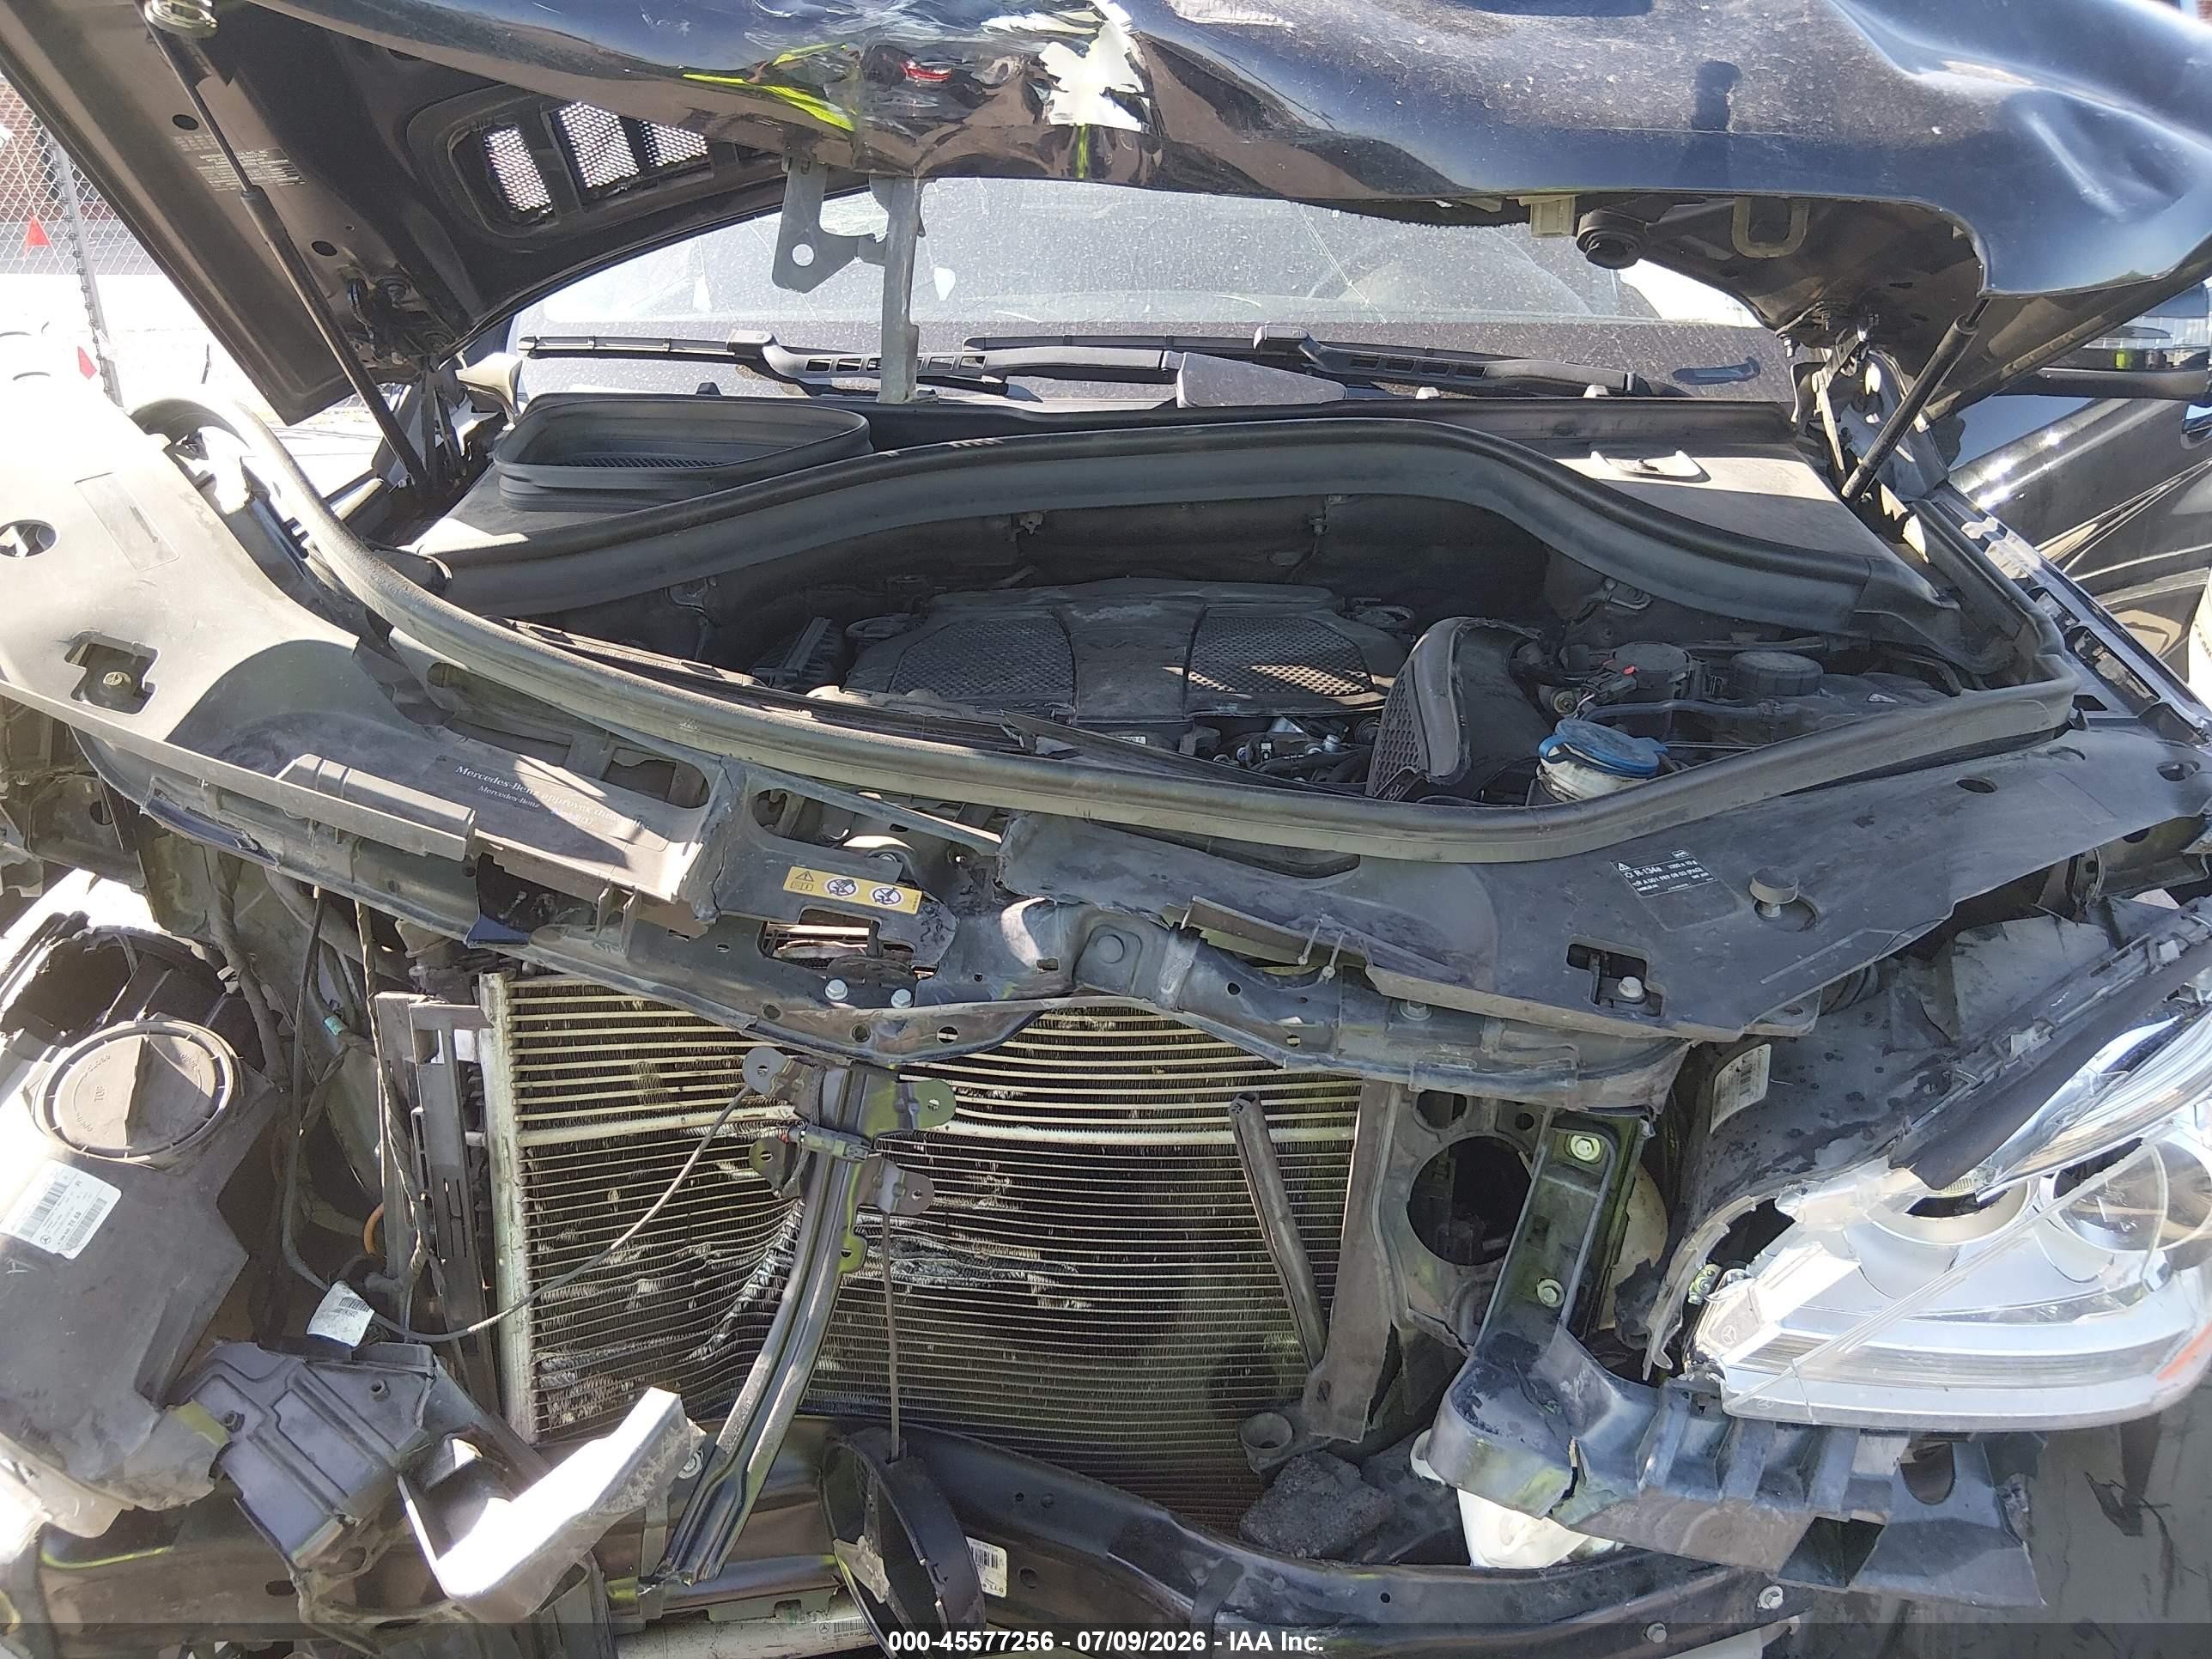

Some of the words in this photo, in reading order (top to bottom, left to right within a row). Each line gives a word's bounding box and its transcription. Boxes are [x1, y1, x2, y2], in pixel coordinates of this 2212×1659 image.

[454, 765, 539, 797] Mercedes-Benz
[541, 793, 591, 813] approves
[477, 785, 541, 808] Mercedes-Benz
[1634, 867, 1662, 877] R-134a
